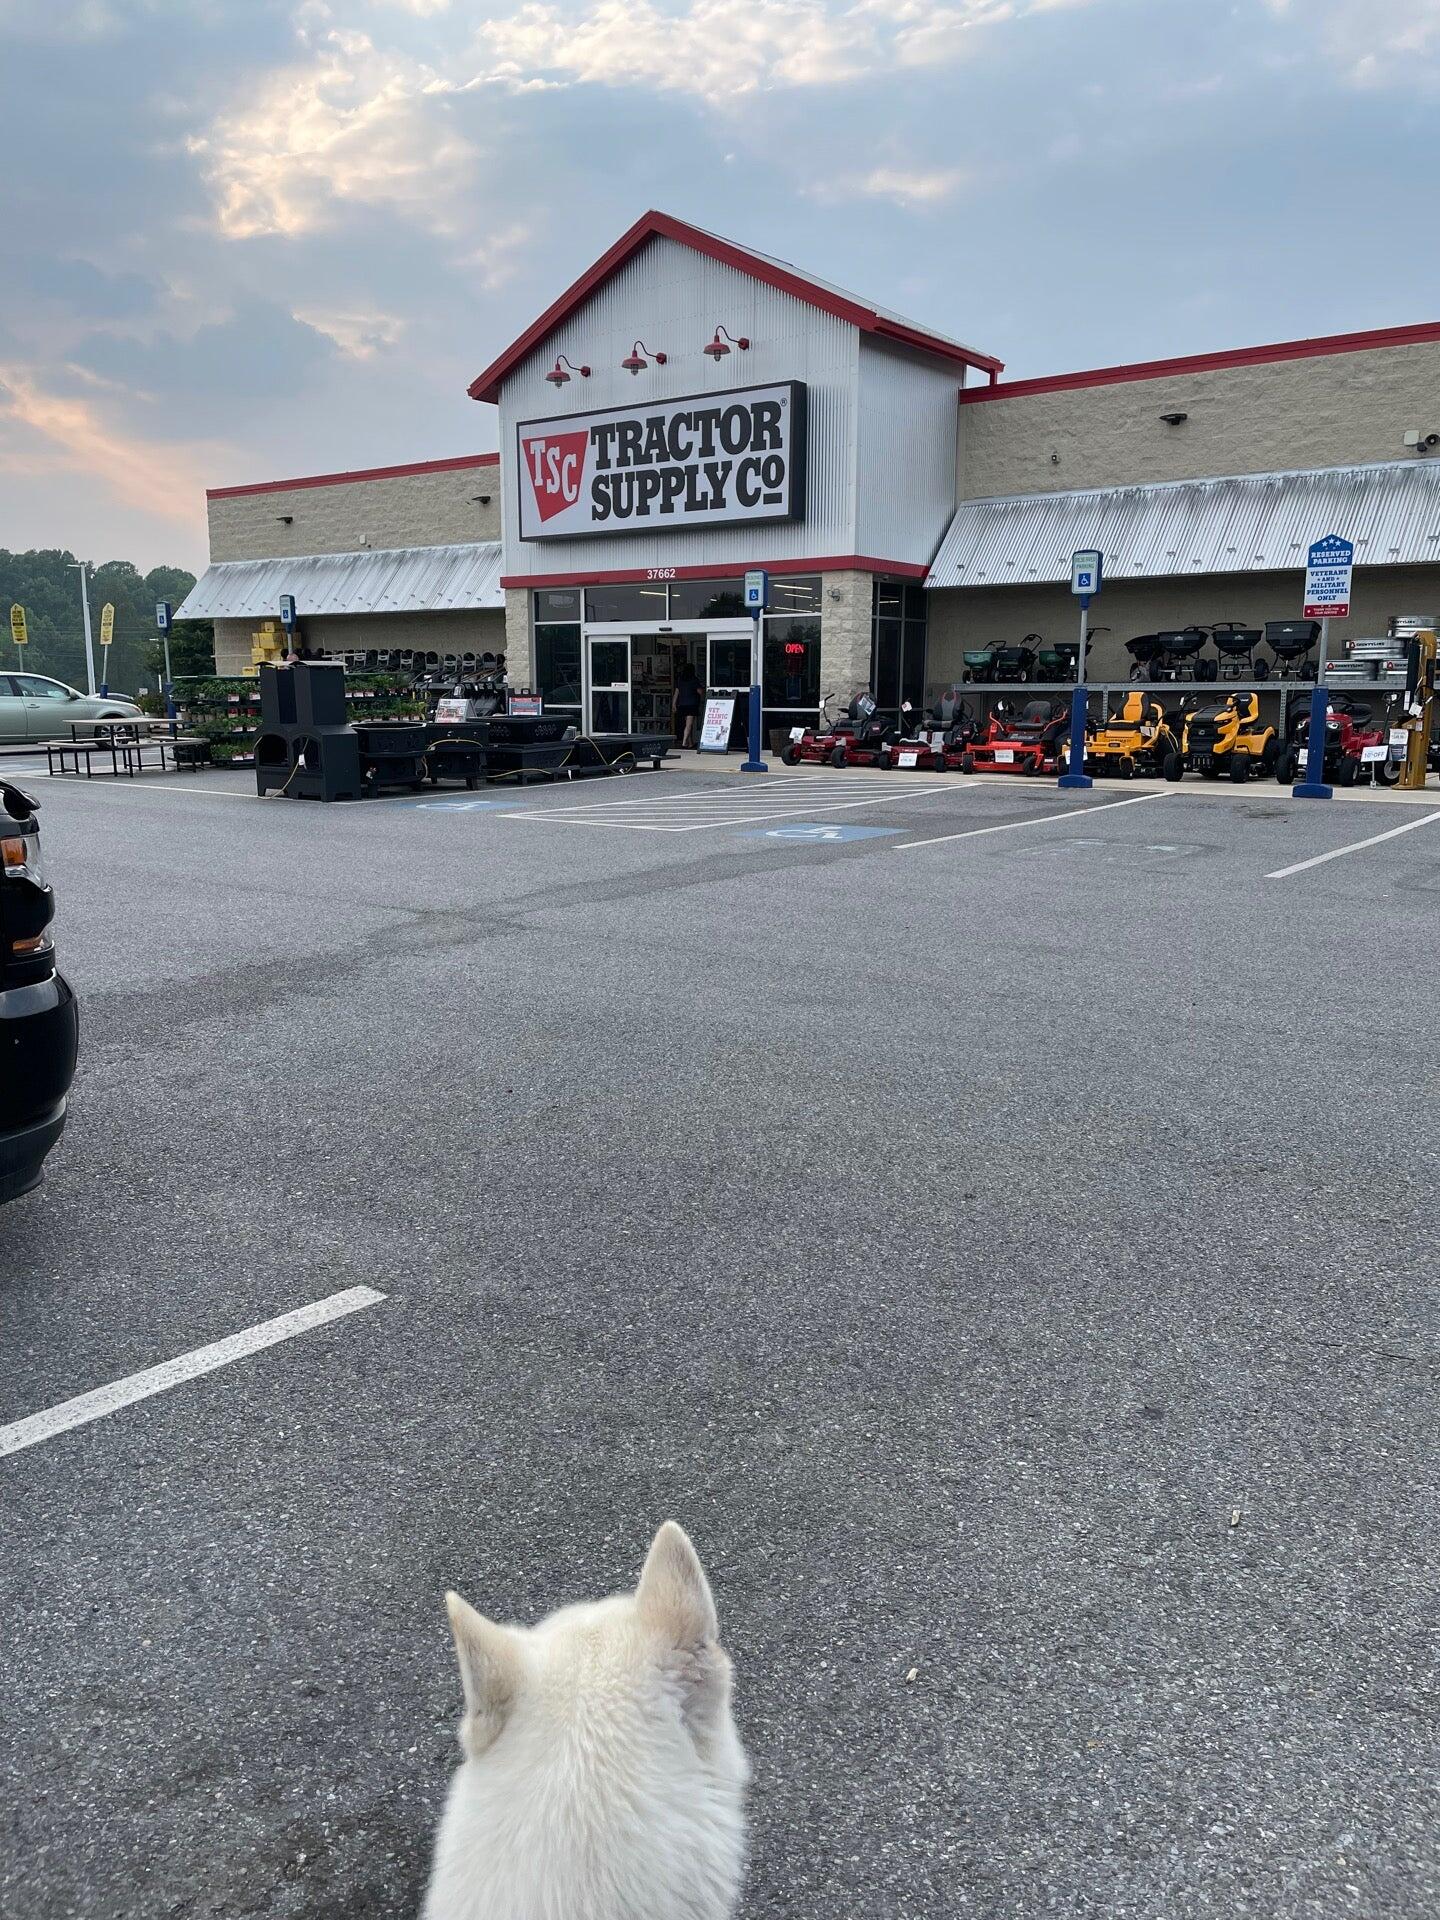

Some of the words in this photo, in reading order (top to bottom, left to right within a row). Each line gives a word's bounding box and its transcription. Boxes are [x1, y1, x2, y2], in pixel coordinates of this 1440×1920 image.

[530, 440, 577, 502] TSC
[591, 461, 733, 521] SUPPLY
[1311, 550, 1351, 559] RESERVED
[1313, 557, 1348, 565] PARKING
[647, 568, 676, 579] 37662
[1310, 569, 1348, 577] VETERANS
[1310, 581, 1346, 589] MILITARY
[785, 643, 804, 654] OPEN
